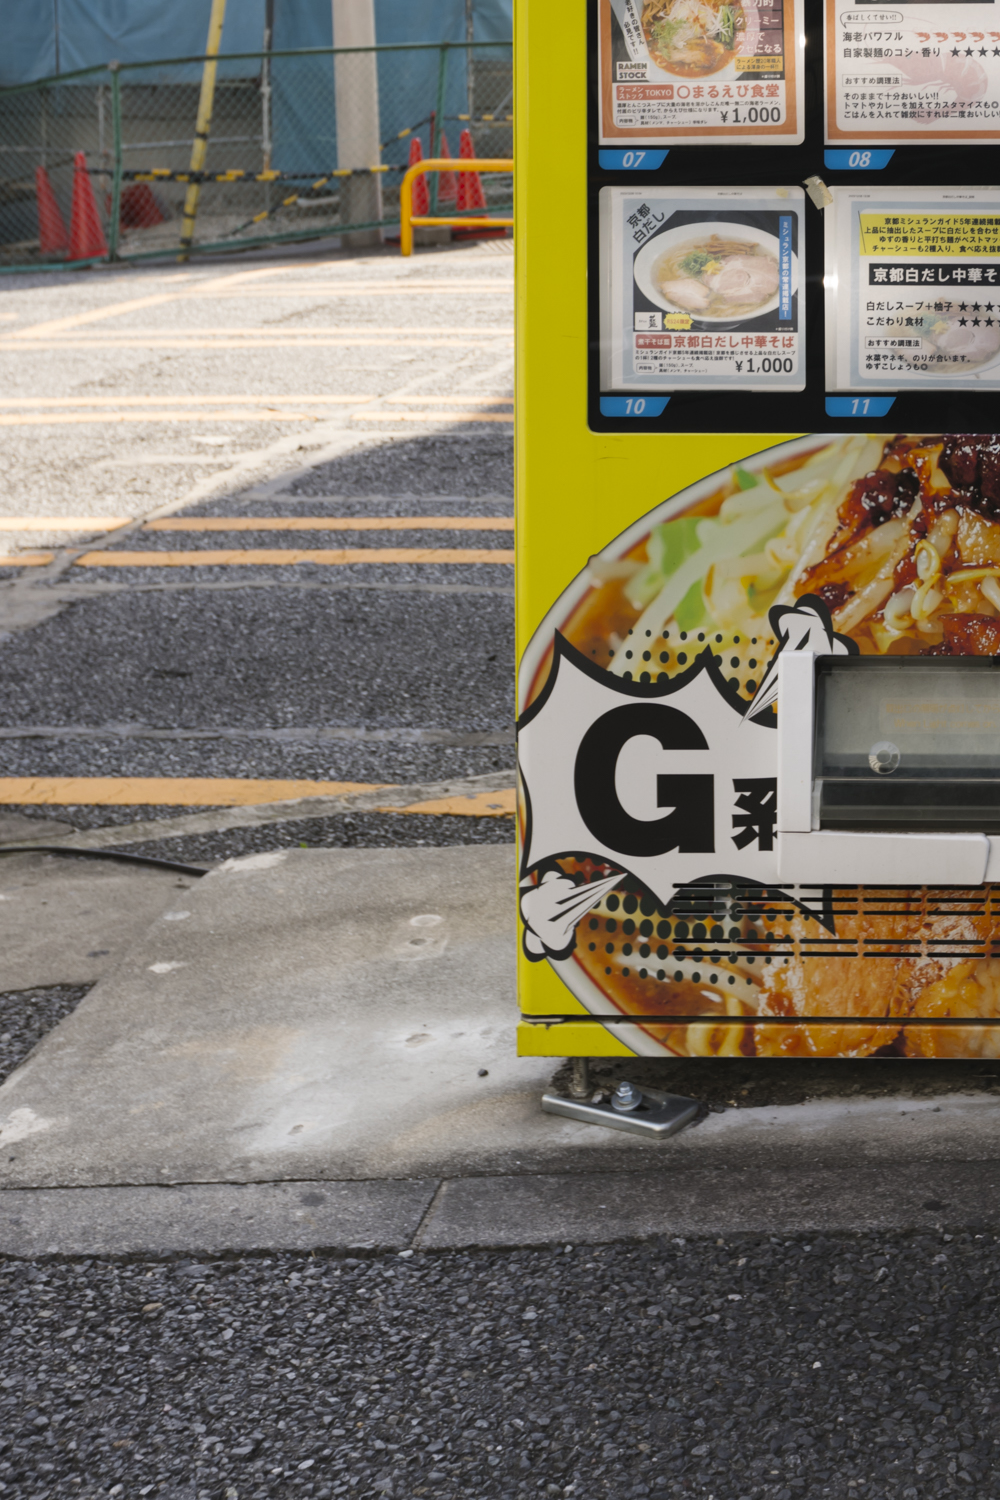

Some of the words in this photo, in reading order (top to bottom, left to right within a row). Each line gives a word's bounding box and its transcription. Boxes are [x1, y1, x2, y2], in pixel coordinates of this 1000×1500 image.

[736, 16, 779, 26] クリーミー
[843, 32, 903, 42] 海老パワフル
[843, 48, 941, 58] 自家製麺のコシ・香り
[845, 77, 900, 85] おすすめ調理法
[645, 89, 671, 97] TOKYO
[720, 107, 781, 123] ¥1,000
[622, 152, 646, 167] 07
[849, 152, 871, 167] 08
[626, 203, 651, 229] 京都
[632, 211, 665, 243] 白だし
[866, 316, 924, 327] こだわり食材
[674, 336, 794, 348] 京都白だし中華そば
[735, 358, 793, 374] ¥1,000
[625, 399, 645, 414] 10
[851, 399, 870, 414] 11
